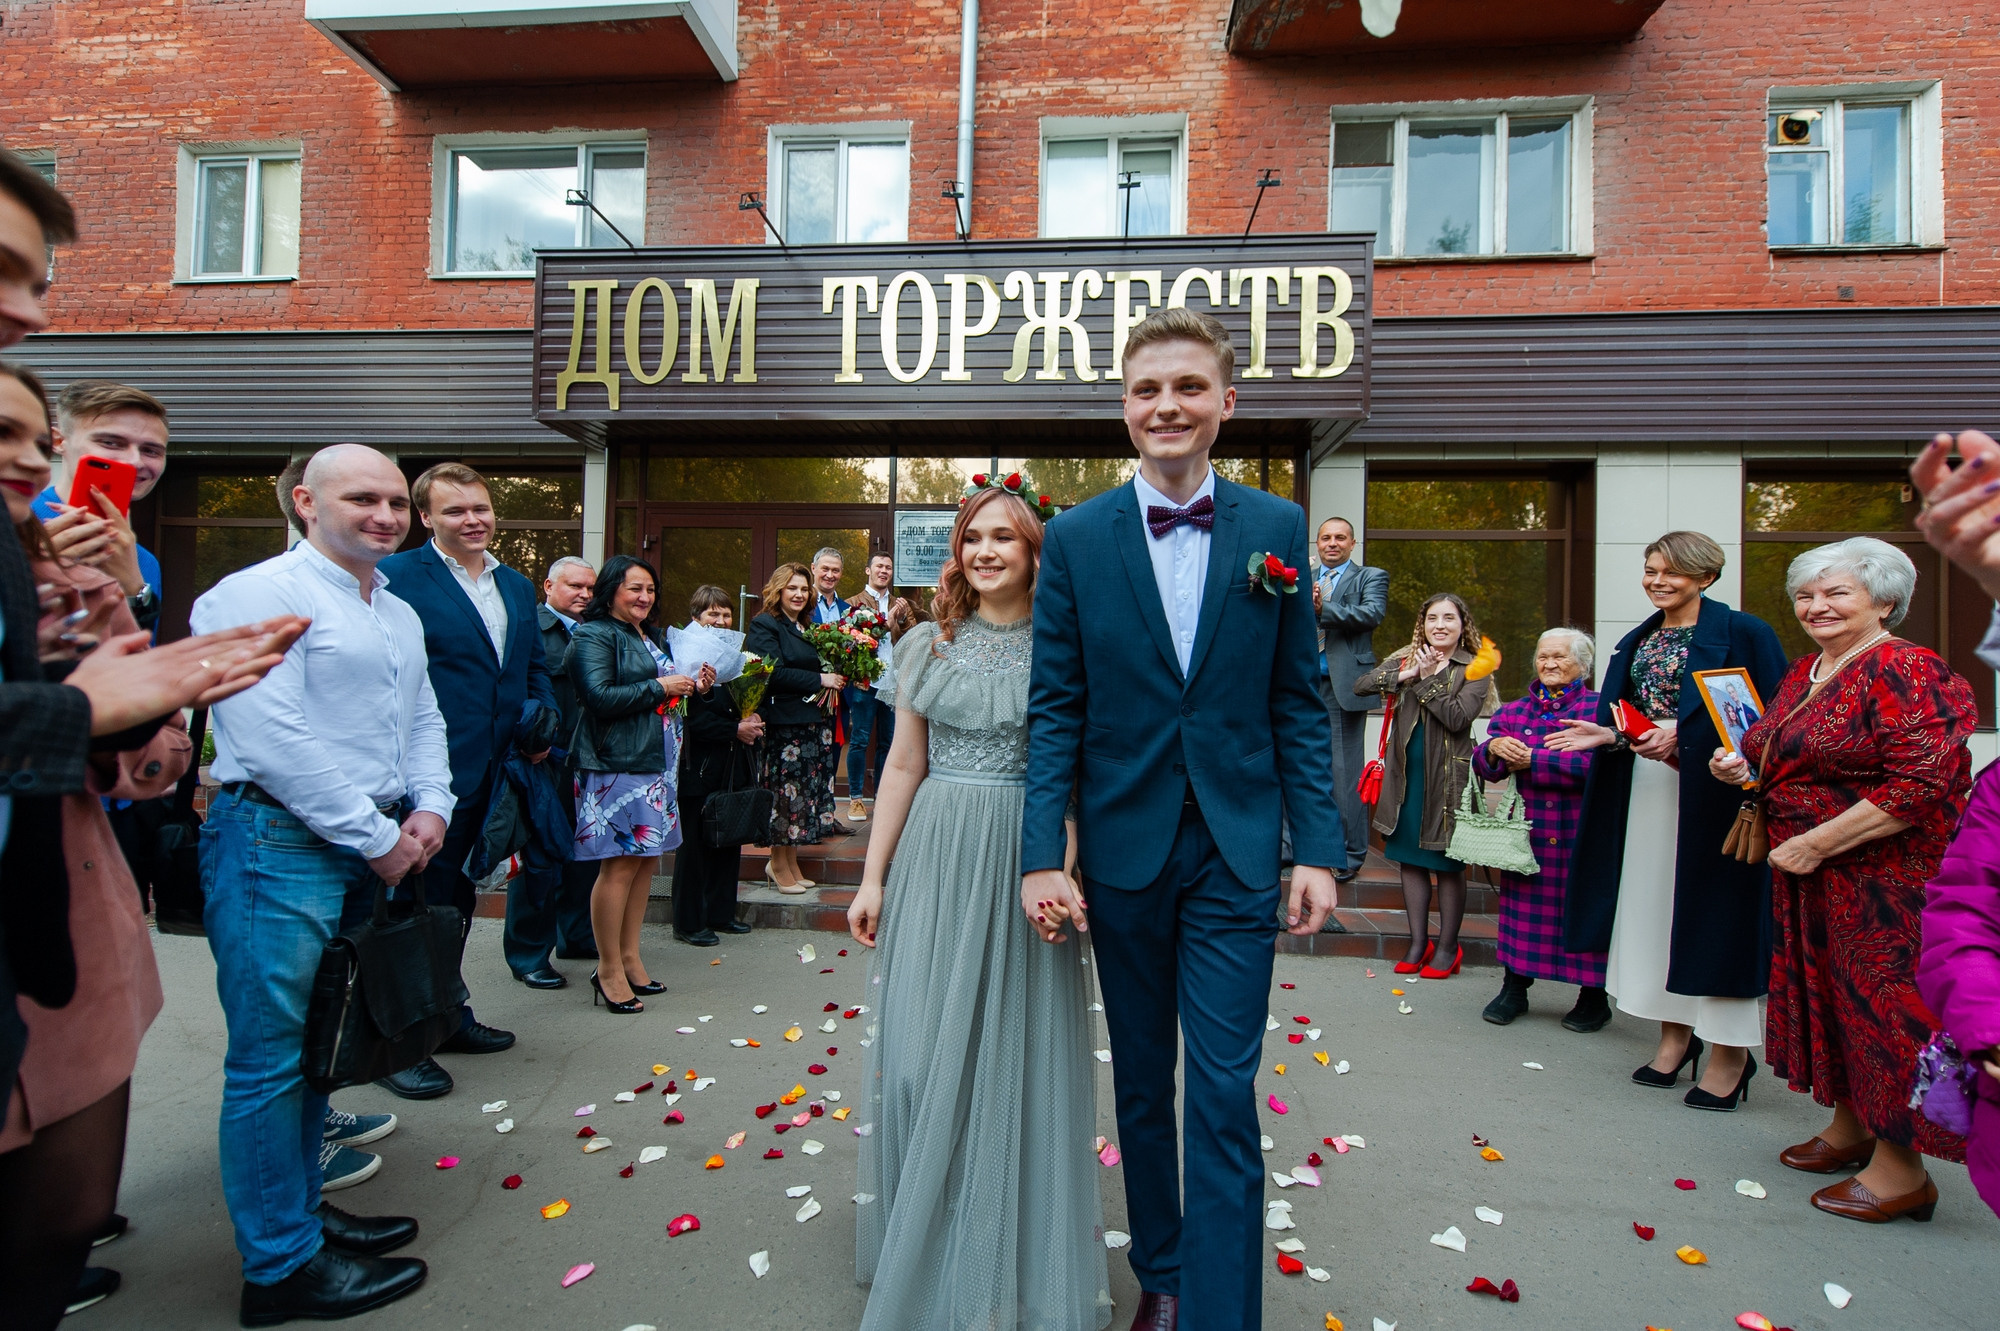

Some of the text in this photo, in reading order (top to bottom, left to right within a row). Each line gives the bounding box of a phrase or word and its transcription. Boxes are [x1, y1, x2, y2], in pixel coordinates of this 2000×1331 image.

[556, 277, 760, 410] ДОМ
[916, 545, 934, 556] 9.00
[939, 548, 949, 557] до
